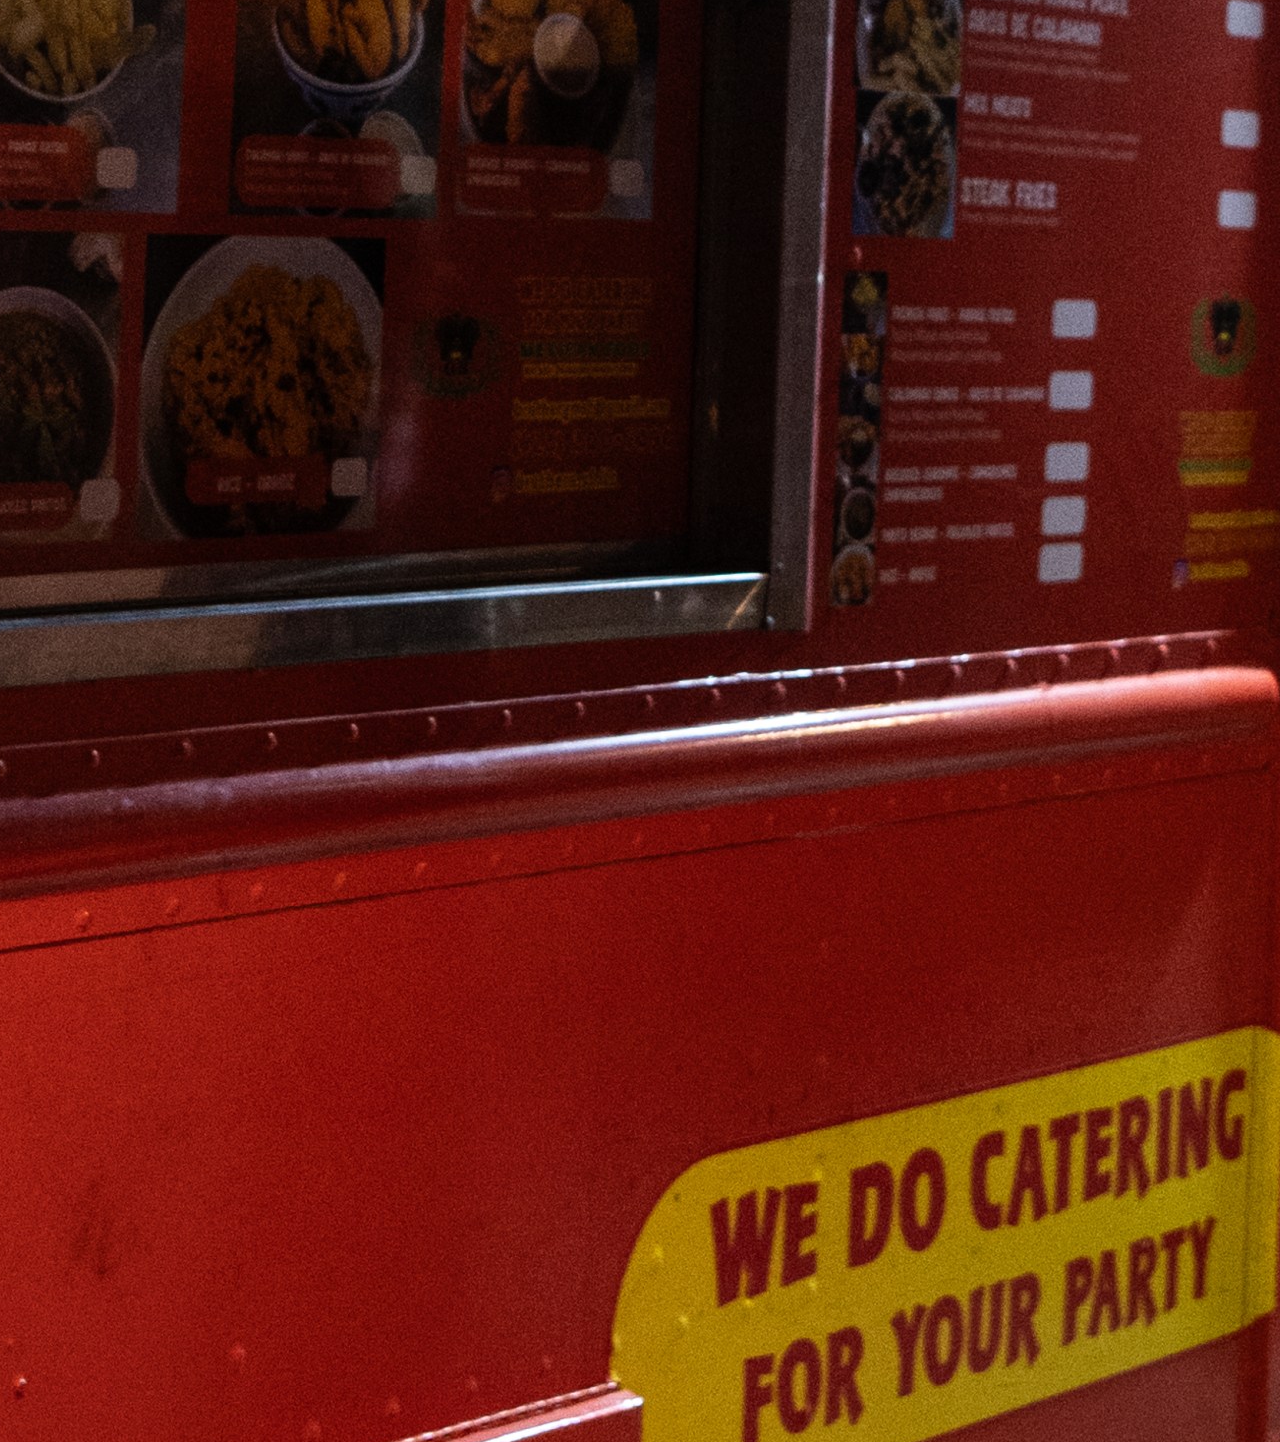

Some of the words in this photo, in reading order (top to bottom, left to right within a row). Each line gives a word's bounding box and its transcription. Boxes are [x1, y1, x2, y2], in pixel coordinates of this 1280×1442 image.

[961, 177, 1011, 207] STEAK
[1015, 180, 1059, 210] FRIES
[710, 1182, 819, 1306] WE
[848, 1148, 946, 1268] DO
[971, 1069, 1246, 1231] CATERING
[890, 1272, 1040, 1398] YOUR
[1062, 1217, 1216, 1346] PARTY
